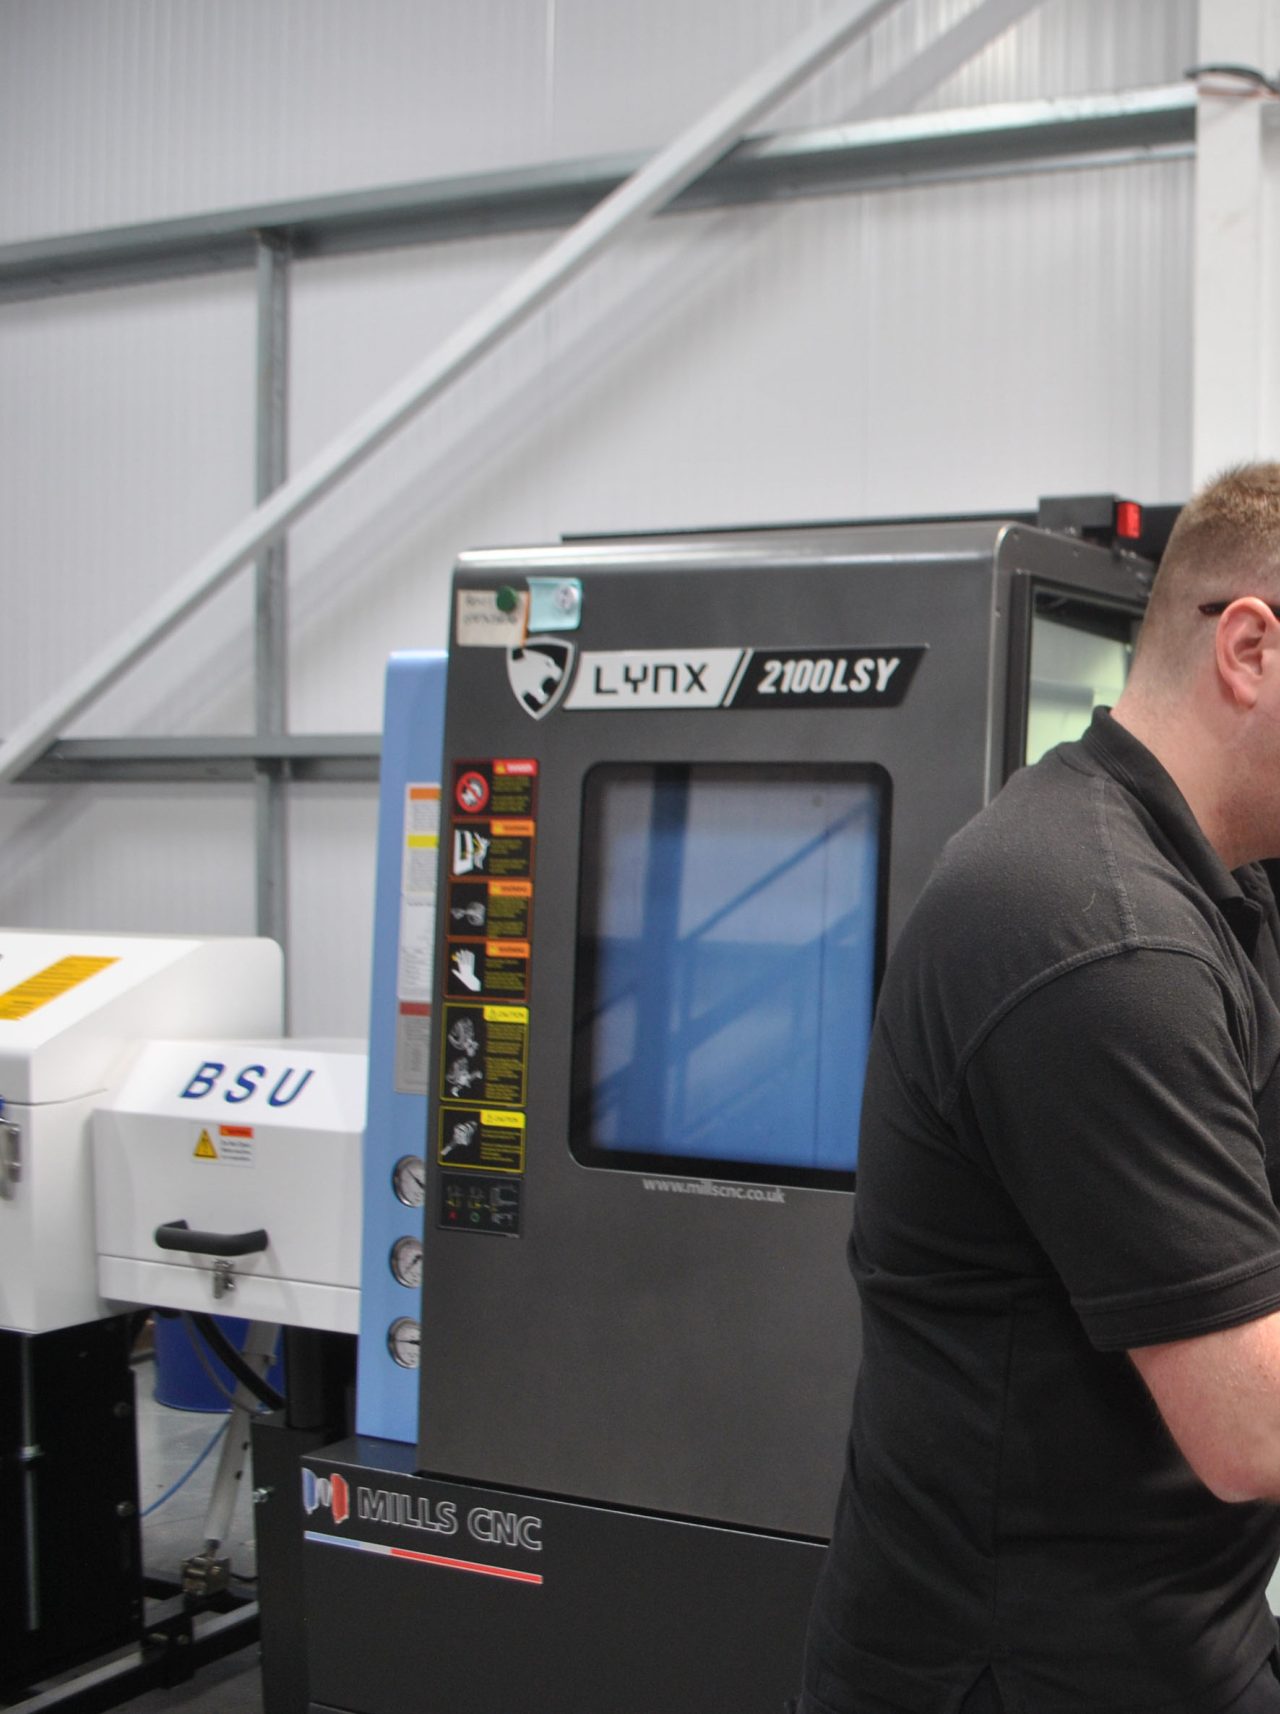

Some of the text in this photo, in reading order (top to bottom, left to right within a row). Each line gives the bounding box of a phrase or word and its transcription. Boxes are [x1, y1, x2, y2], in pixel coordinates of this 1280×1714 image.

[593, 657, 900, 696] LYNX 2100LSY
[178, 1061, 315, 1108] BSU
[642, 1178, 786, 1203] www.millscnc.co.uk
[357, 1486, 543, 1551] MILLS CNC
